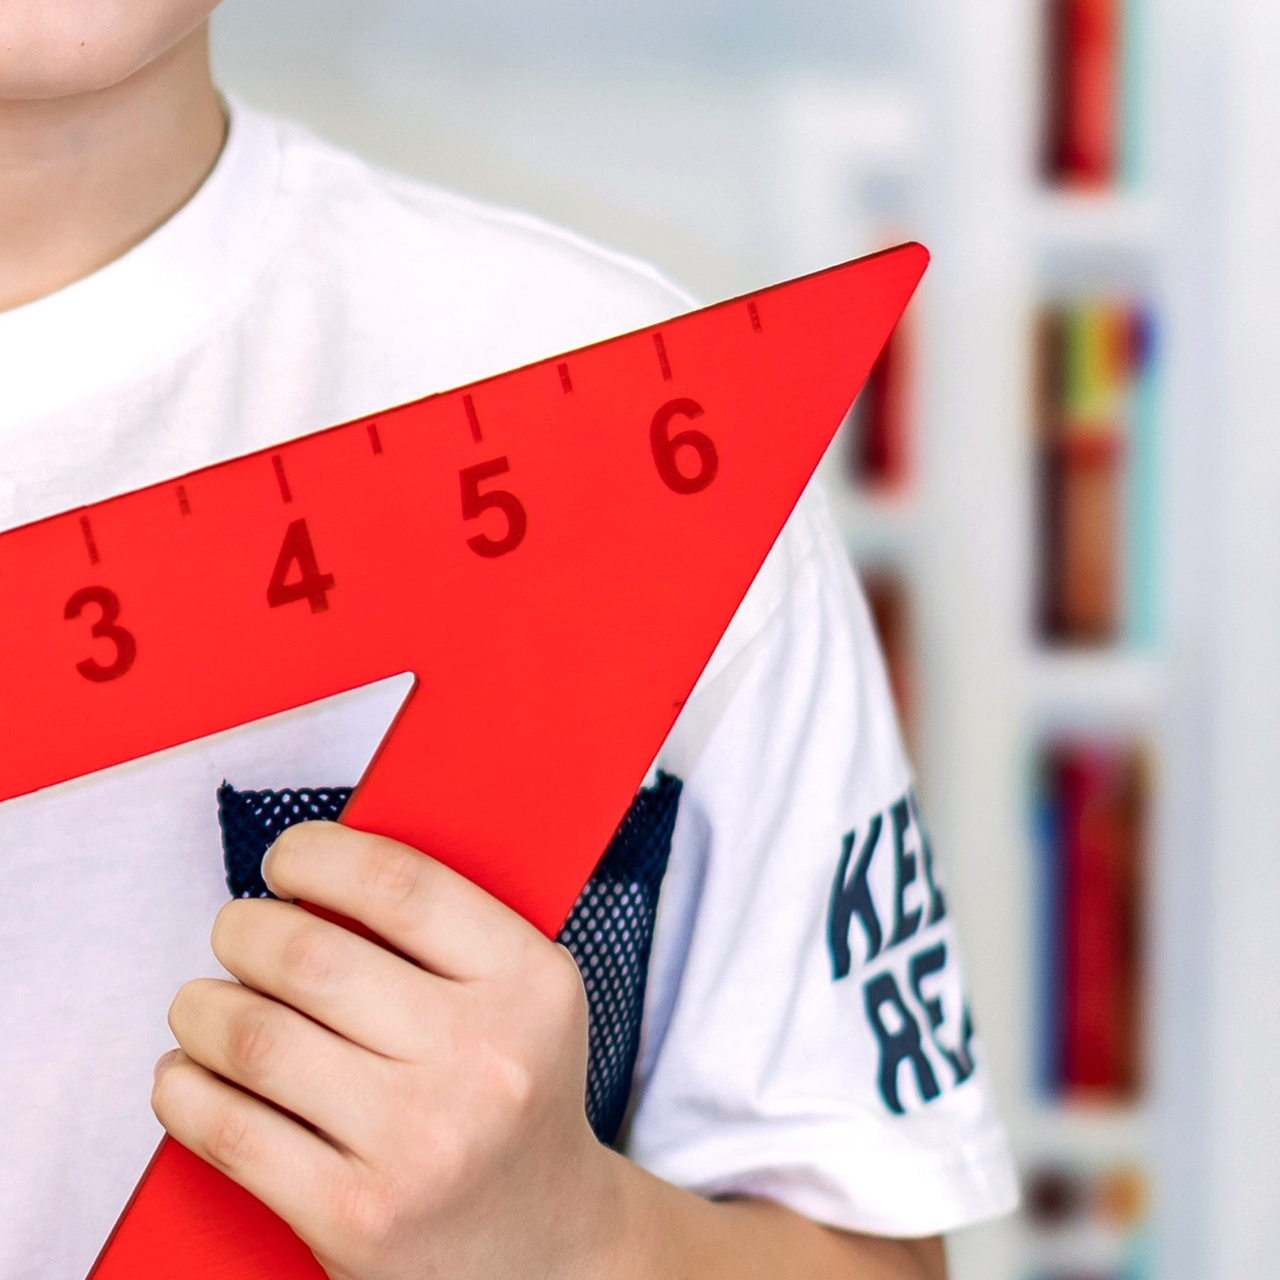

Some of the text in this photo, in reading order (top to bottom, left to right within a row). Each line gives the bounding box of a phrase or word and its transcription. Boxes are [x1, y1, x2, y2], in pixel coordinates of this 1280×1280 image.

[62, 585, 138, 683] 3
[265, 518, 336, 613] 4
[460, 456, 528, 559] 5
[649, 397, 720, 495] 6
